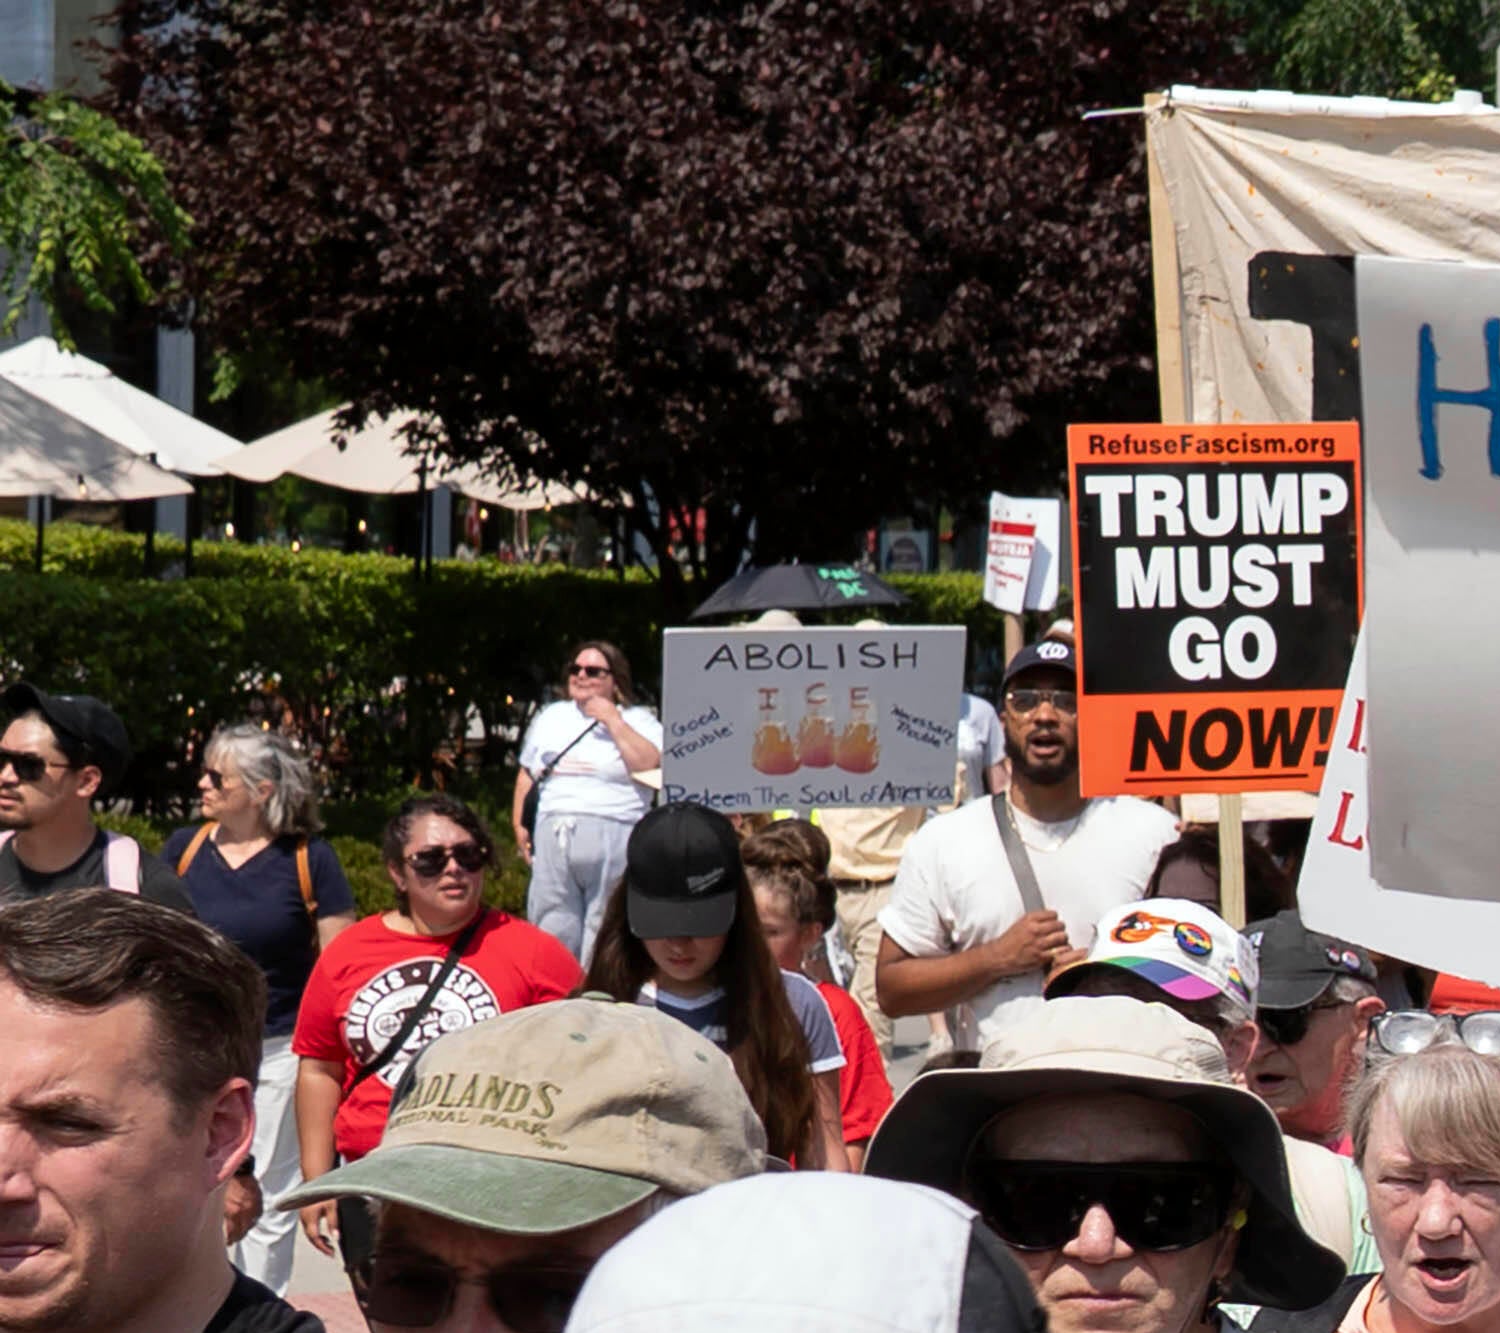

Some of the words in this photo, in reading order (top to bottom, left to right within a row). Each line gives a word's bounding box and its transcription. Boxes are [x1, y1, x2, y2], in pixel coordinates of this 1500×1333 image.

[1089, 432, 1335, 460] RefuseFascism.org
[1084, 472, 1348, 539] TRUMP
[1113, 544, 1326, 610] MUST
[704, 642, 918, 671] ABOLISH
[1167, 617, 1278, 682] GO
[1129, 706, 1332, 772] NOW!
[664, 784, 750, 807] Redeem
[755, 787, 788, 805] The
[428, 962, 497, 1021] ESPEC
[479, 1114, 547, 1137] PARK
